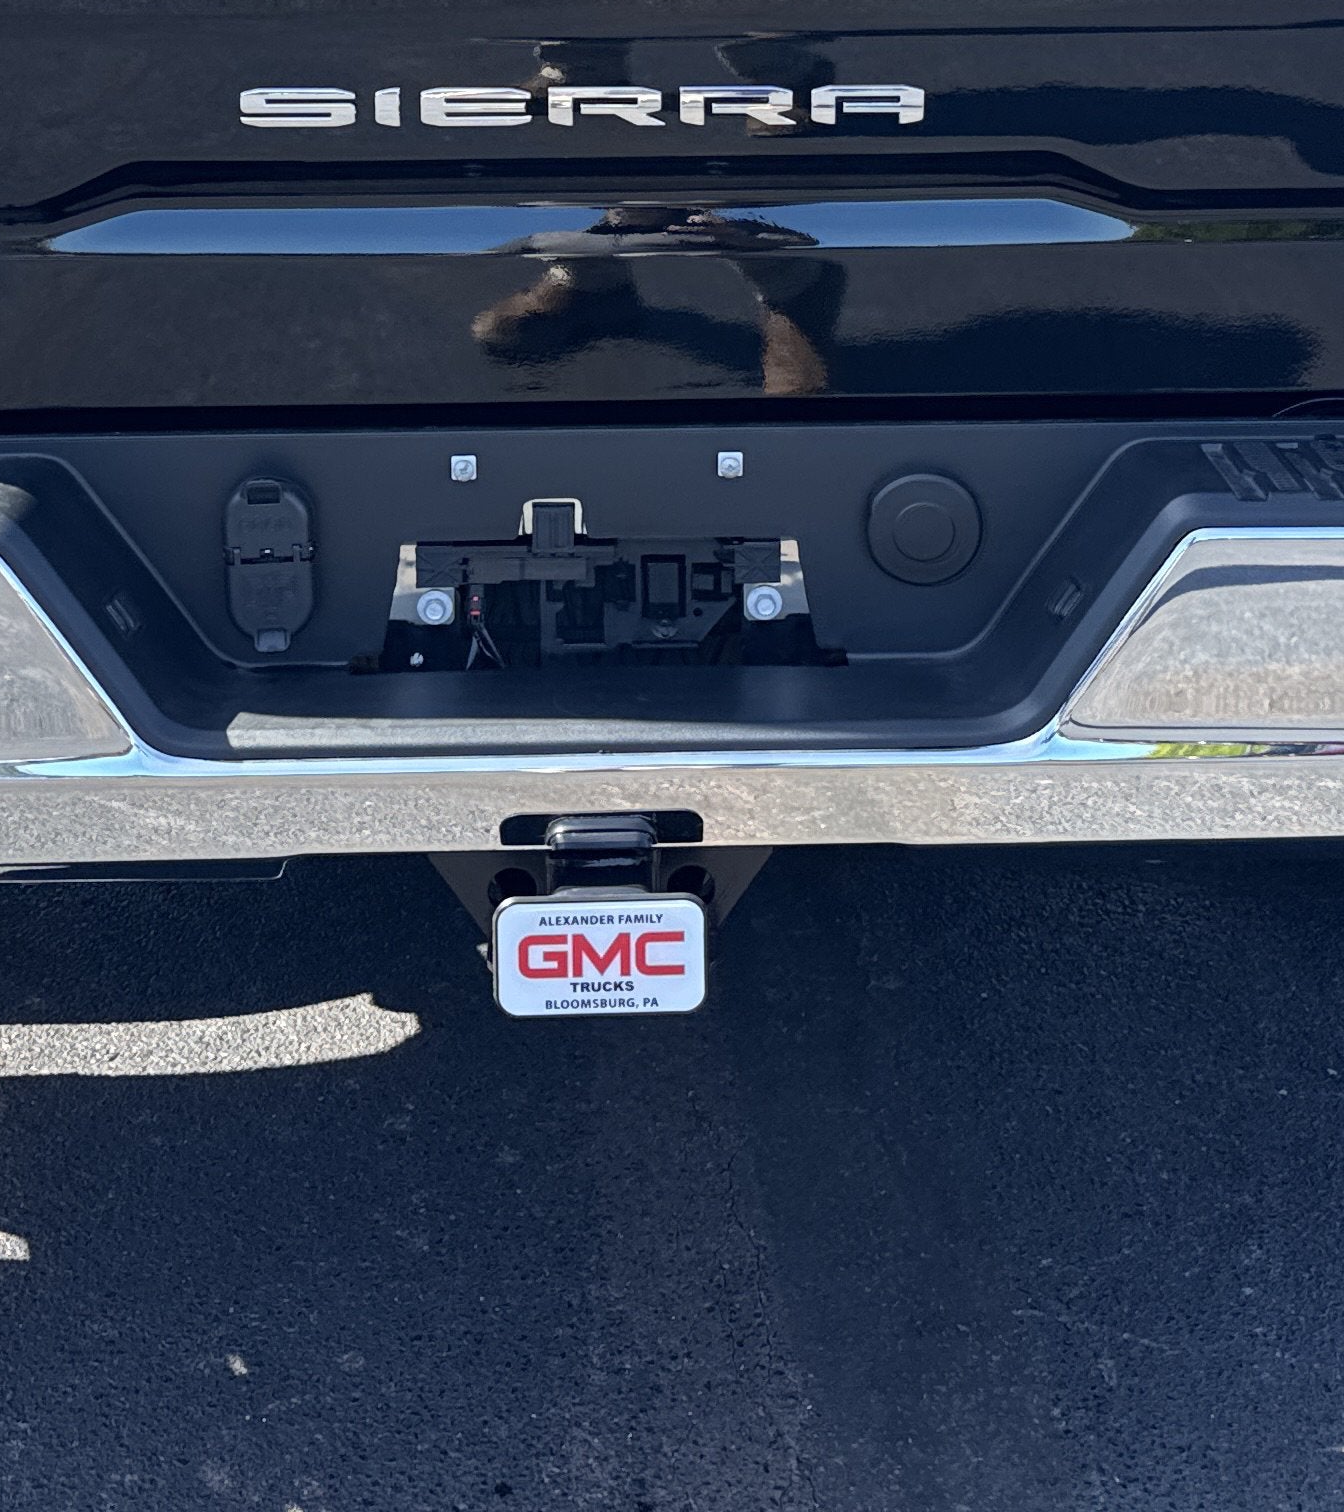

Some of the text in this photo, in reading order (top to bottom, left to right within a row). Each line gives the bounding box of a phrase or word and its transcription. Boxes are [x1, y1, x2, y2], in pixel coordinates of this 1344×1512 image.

[238, 84, 926, 128] SIERRA
[538, 913, 664, 927] ALEXANDER FAMILY
[517, 930, 686, 979] GMC
[570, 980, 635, 993] TRUCKS
[544, 996, 660, 1010] BLOOMSBURG, PA
